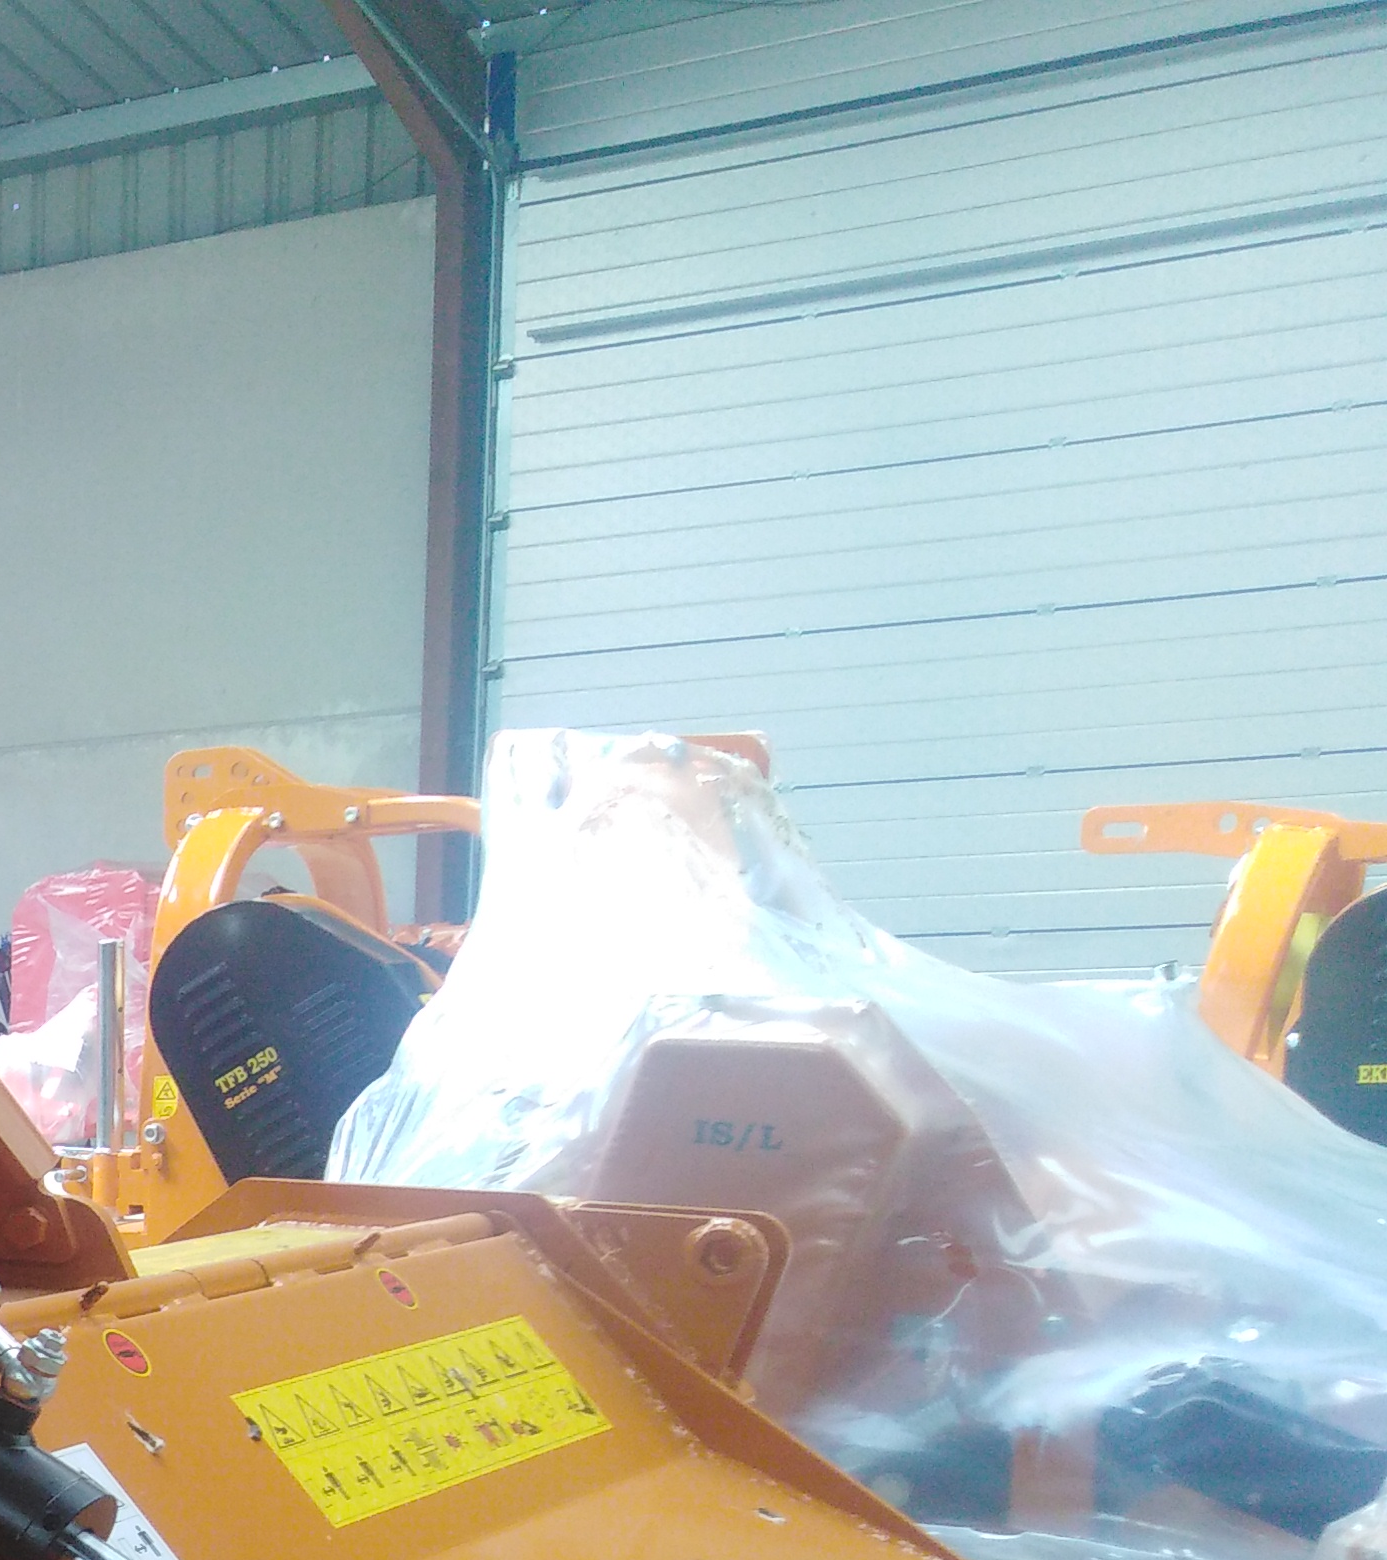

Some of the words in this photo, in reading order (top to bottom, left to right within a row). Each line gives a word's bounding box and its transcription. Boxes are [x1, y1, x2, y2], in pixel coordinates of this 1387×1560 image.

[215, 1065, 248, 1094] TFB
[247, 1046, 278, 1075] 250
[693, 1119, 784, 1151] IS/L
